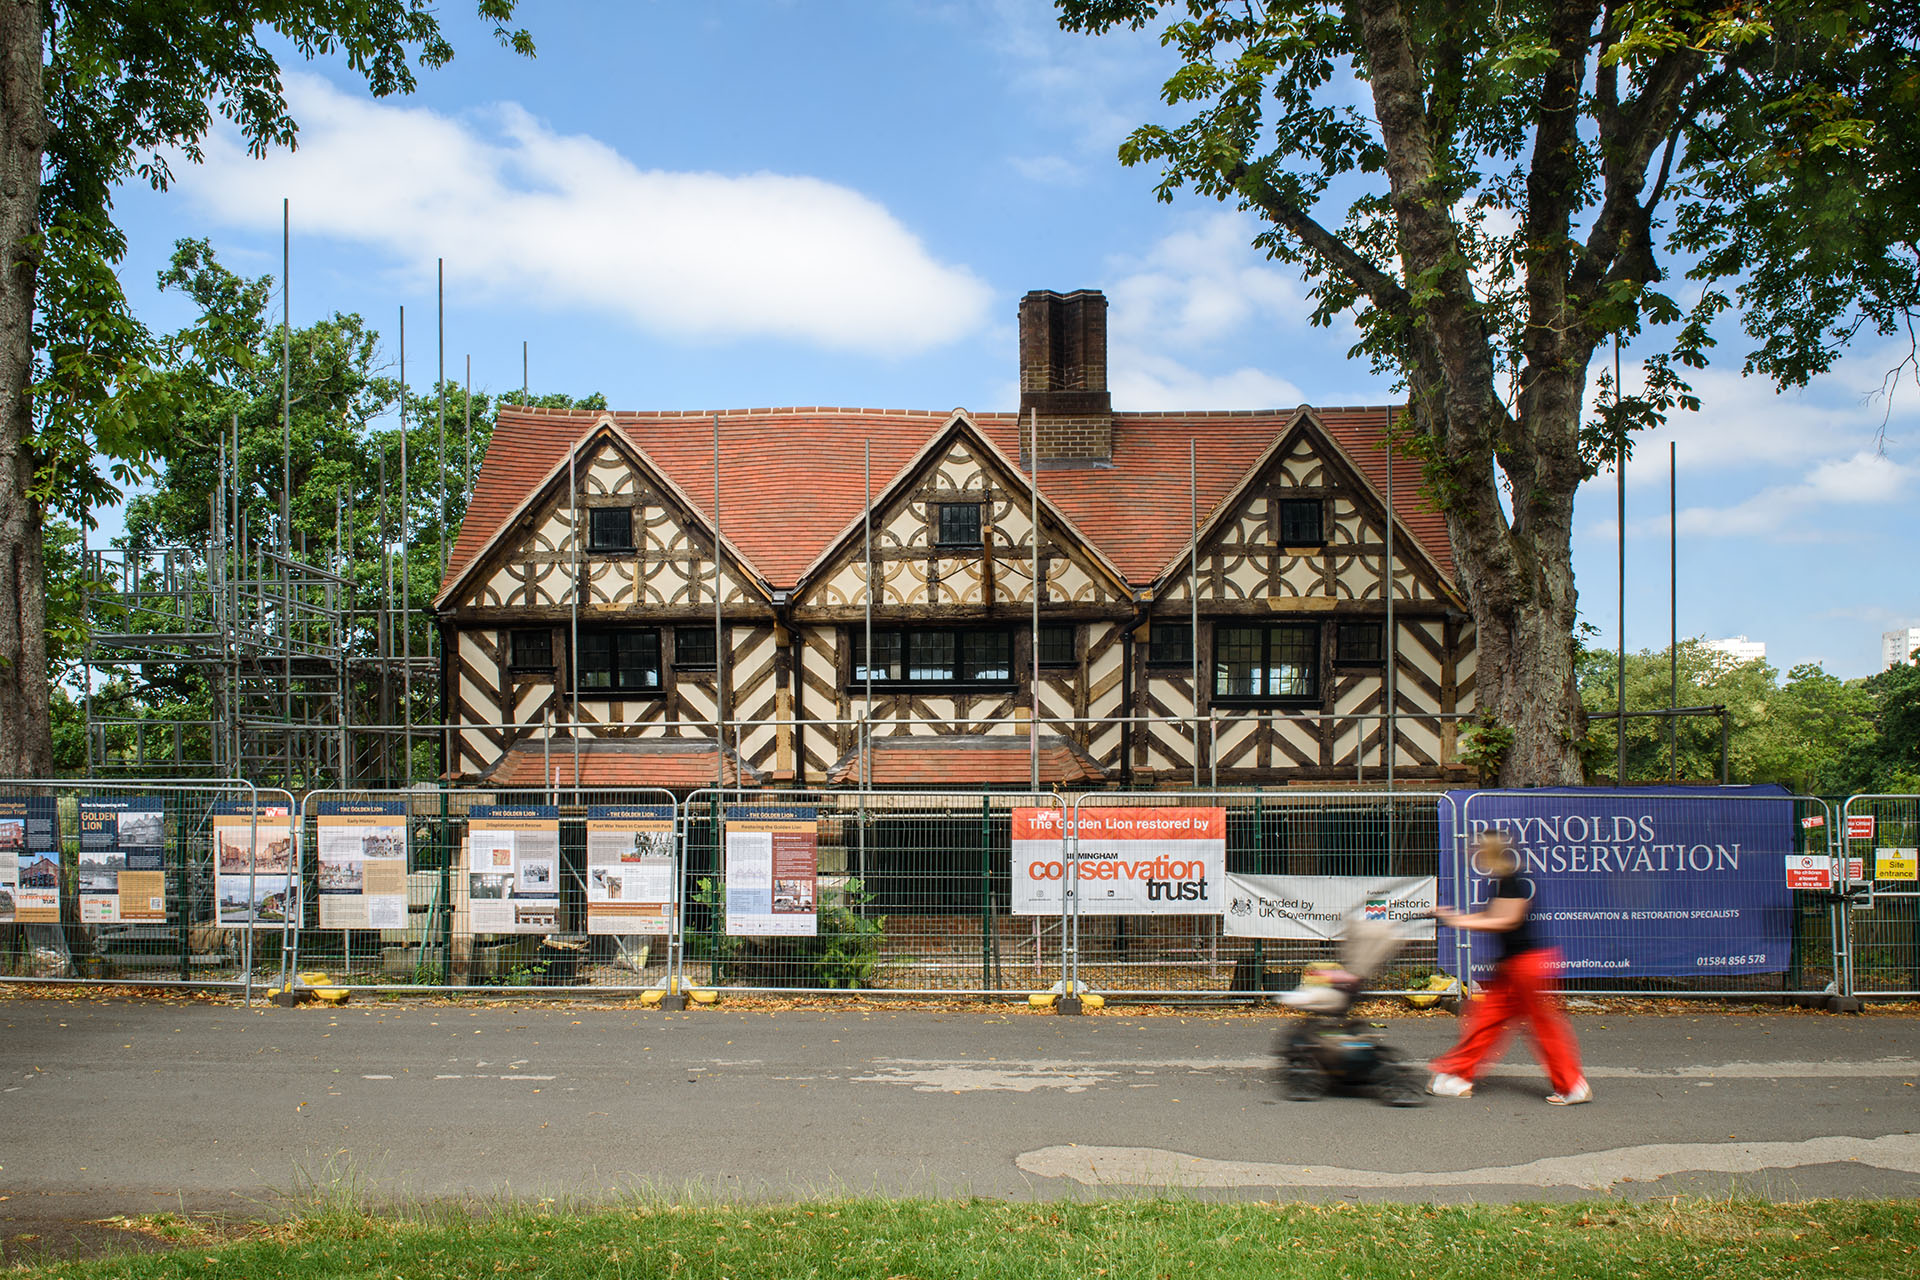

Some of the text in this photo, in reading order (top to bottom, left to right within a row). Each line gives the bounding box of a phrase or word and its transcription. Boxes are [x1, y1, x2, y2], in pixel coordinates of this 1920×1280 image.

[81, 811, 116, 821] GOLDEN
[82, 821, 103, 830] LION
[1028, 818, 1209, 831] The Goden Lion restored by
[1469, 815, 1655, 846] REYNOLDS
[1066, 852, 1119, 860] BIMINGHAM
[1470, 843, 1741, 876] CONSERVATION
[1028, 854, 1205, 881] conservation
[1146, 876, 1208, 901] trust
[1258, 897, 1314, 911] Funded by
[1388, 899, 1431, 909] Historic
[1258, 908, 1342, 921] UK Government
[1554, 911, 1620, 921] CONSERVATION
[1621, 912, 1632, 920] &
[1631, 911, 1689, 920] RESTORATION
[1690, 909, 1740, 919] SPECIALISTS
[1696, 954, 1766, 967] 01584 856 578
